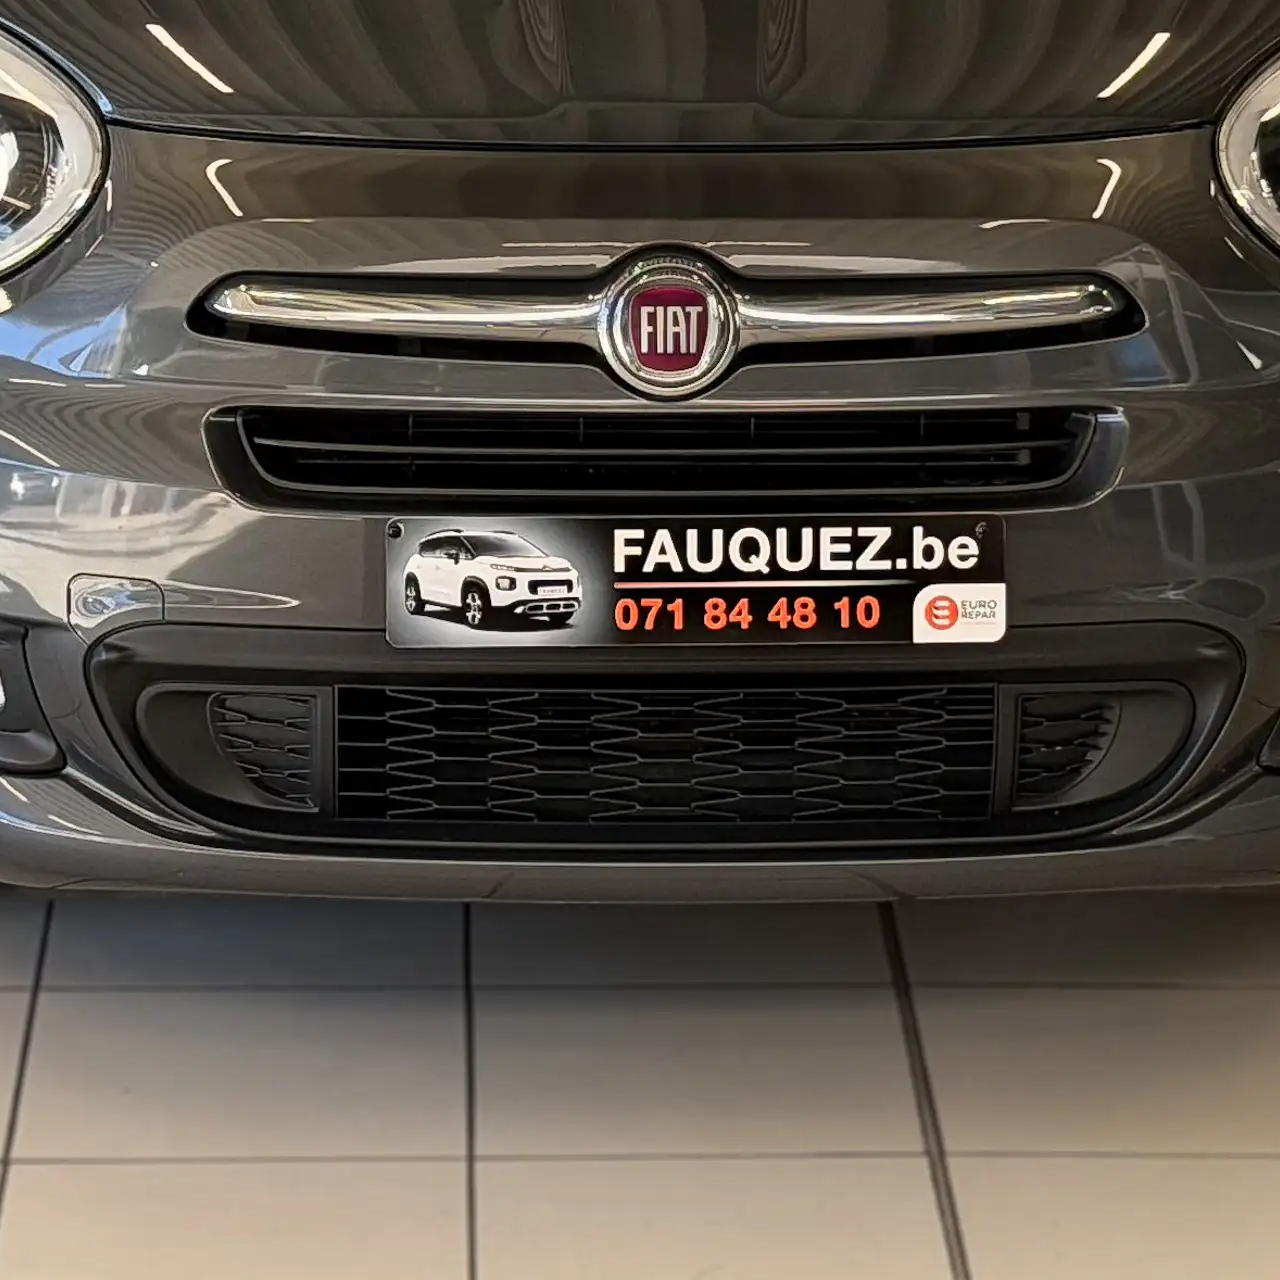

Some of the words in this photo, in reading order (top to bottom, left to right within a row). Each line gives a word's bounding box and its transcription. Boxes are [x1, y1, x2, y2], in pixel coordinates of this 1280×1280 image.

[640, 305, 703, 354] FIAT
[613, 525, 980, 574] FAUQUEZ.be
[615, 597, 684, 631] 071
[703, 596, 754, 631] 84
[767, 596, 818, 630] 48
[833, 595, 881, 629] 10
[960, 599, 998, 610] EURO
[960, 610, 997, 620] REPAR
